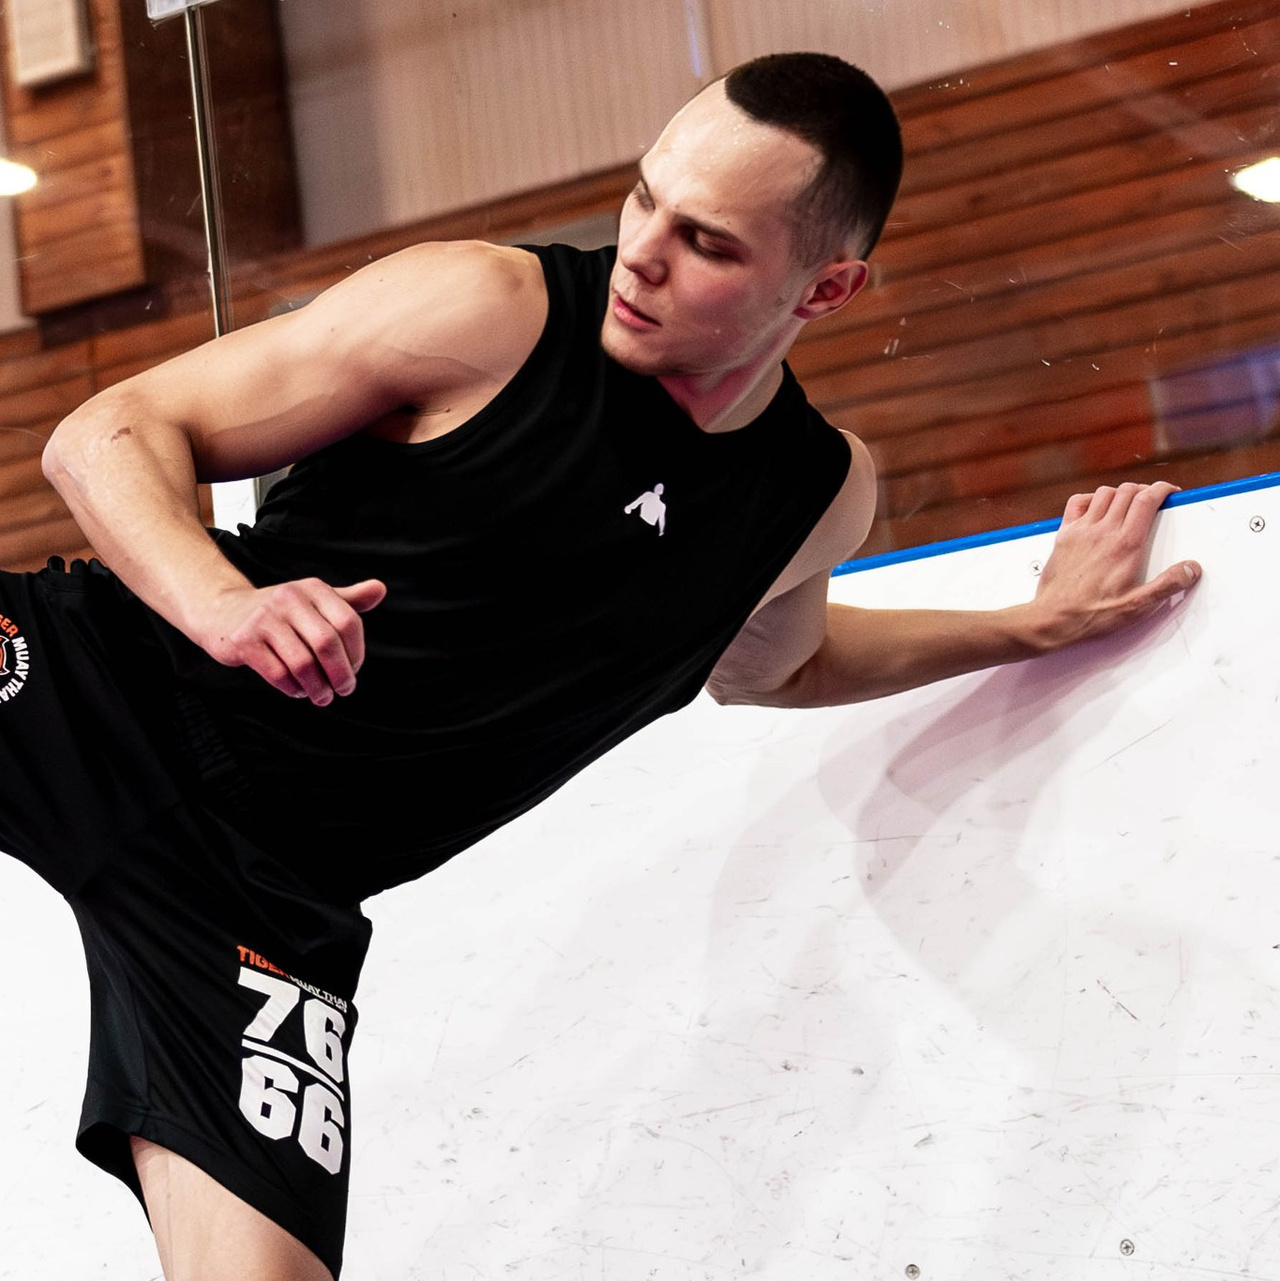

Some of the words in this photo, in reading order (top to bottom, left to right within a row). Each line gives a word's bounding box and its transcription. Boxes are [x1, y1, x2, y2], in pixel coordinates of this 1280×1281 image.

[11, 636, 30, 681] MUAY
[237, 966, 347, 1084] 76
[238, 1054, 345, 1175] 66
